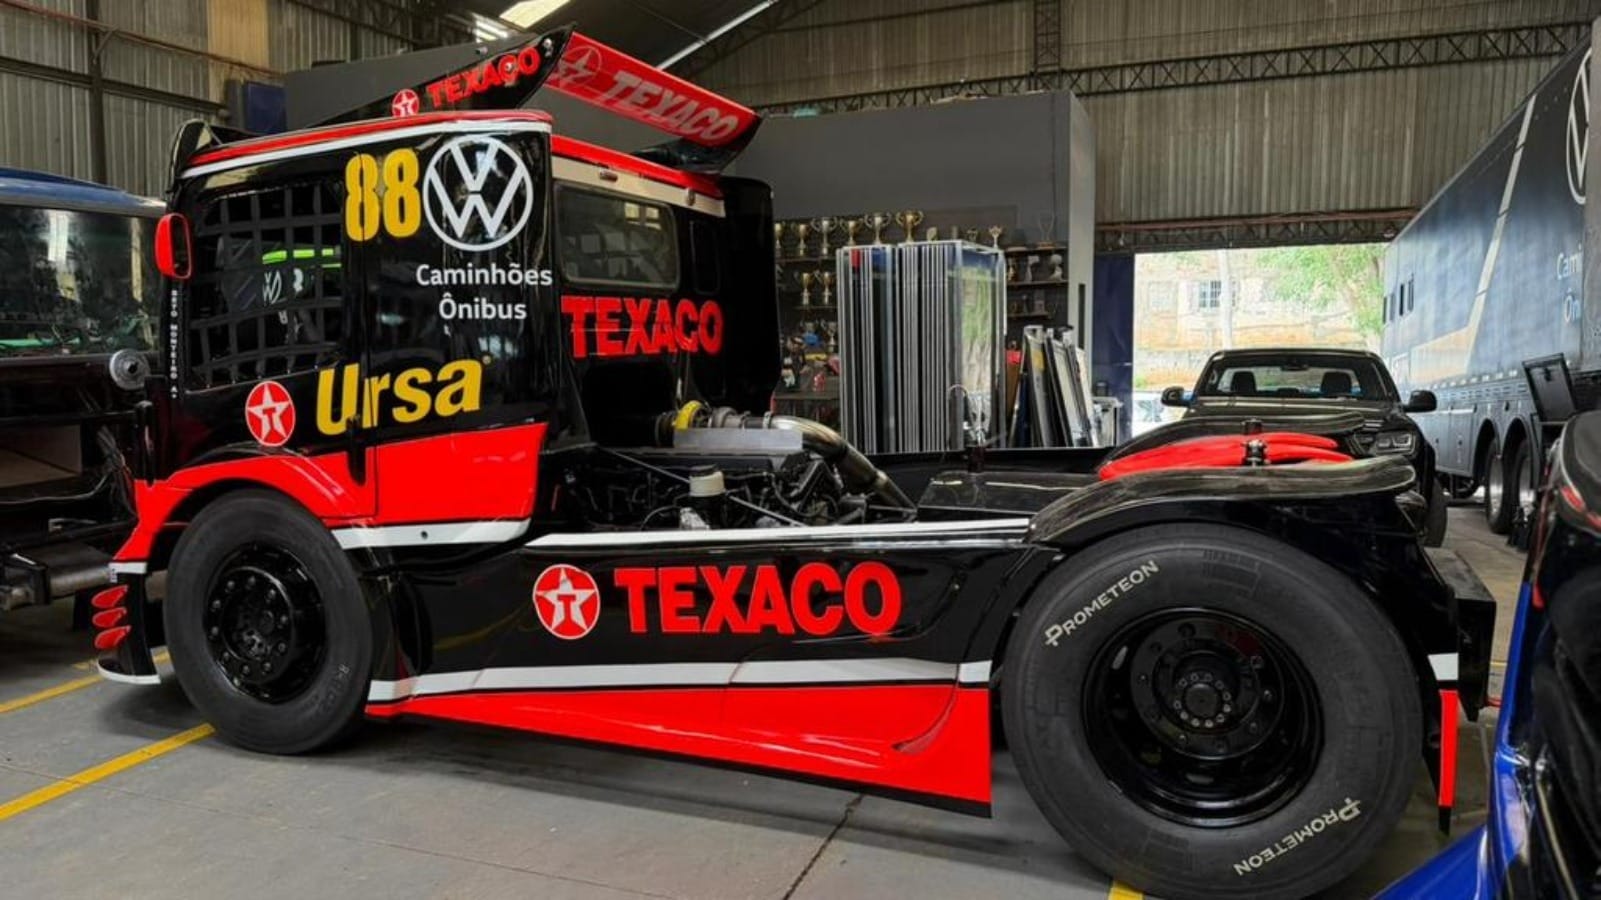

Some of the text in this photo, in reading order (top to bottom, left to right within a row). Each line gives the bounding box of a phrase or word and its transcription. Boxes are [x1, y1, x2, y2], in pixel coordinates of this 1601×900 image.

[426, 46, 541, 107] TEXACO
[600, 69, 739, 140] TEXACO
[345, 148, 422, 242] 88
[415, 262, 553, 287] Caminhões
[438, 292, 528, 320] Ônibus
[560, 295, 724, 358] TEXACO
[316, 358, 483, 436] Ursa
[614, 561, 902, 636] TEXACO
[1044, 560, 1160, 647] PROMETEON
[1232, 797, 1362, 876] PROMETEON
